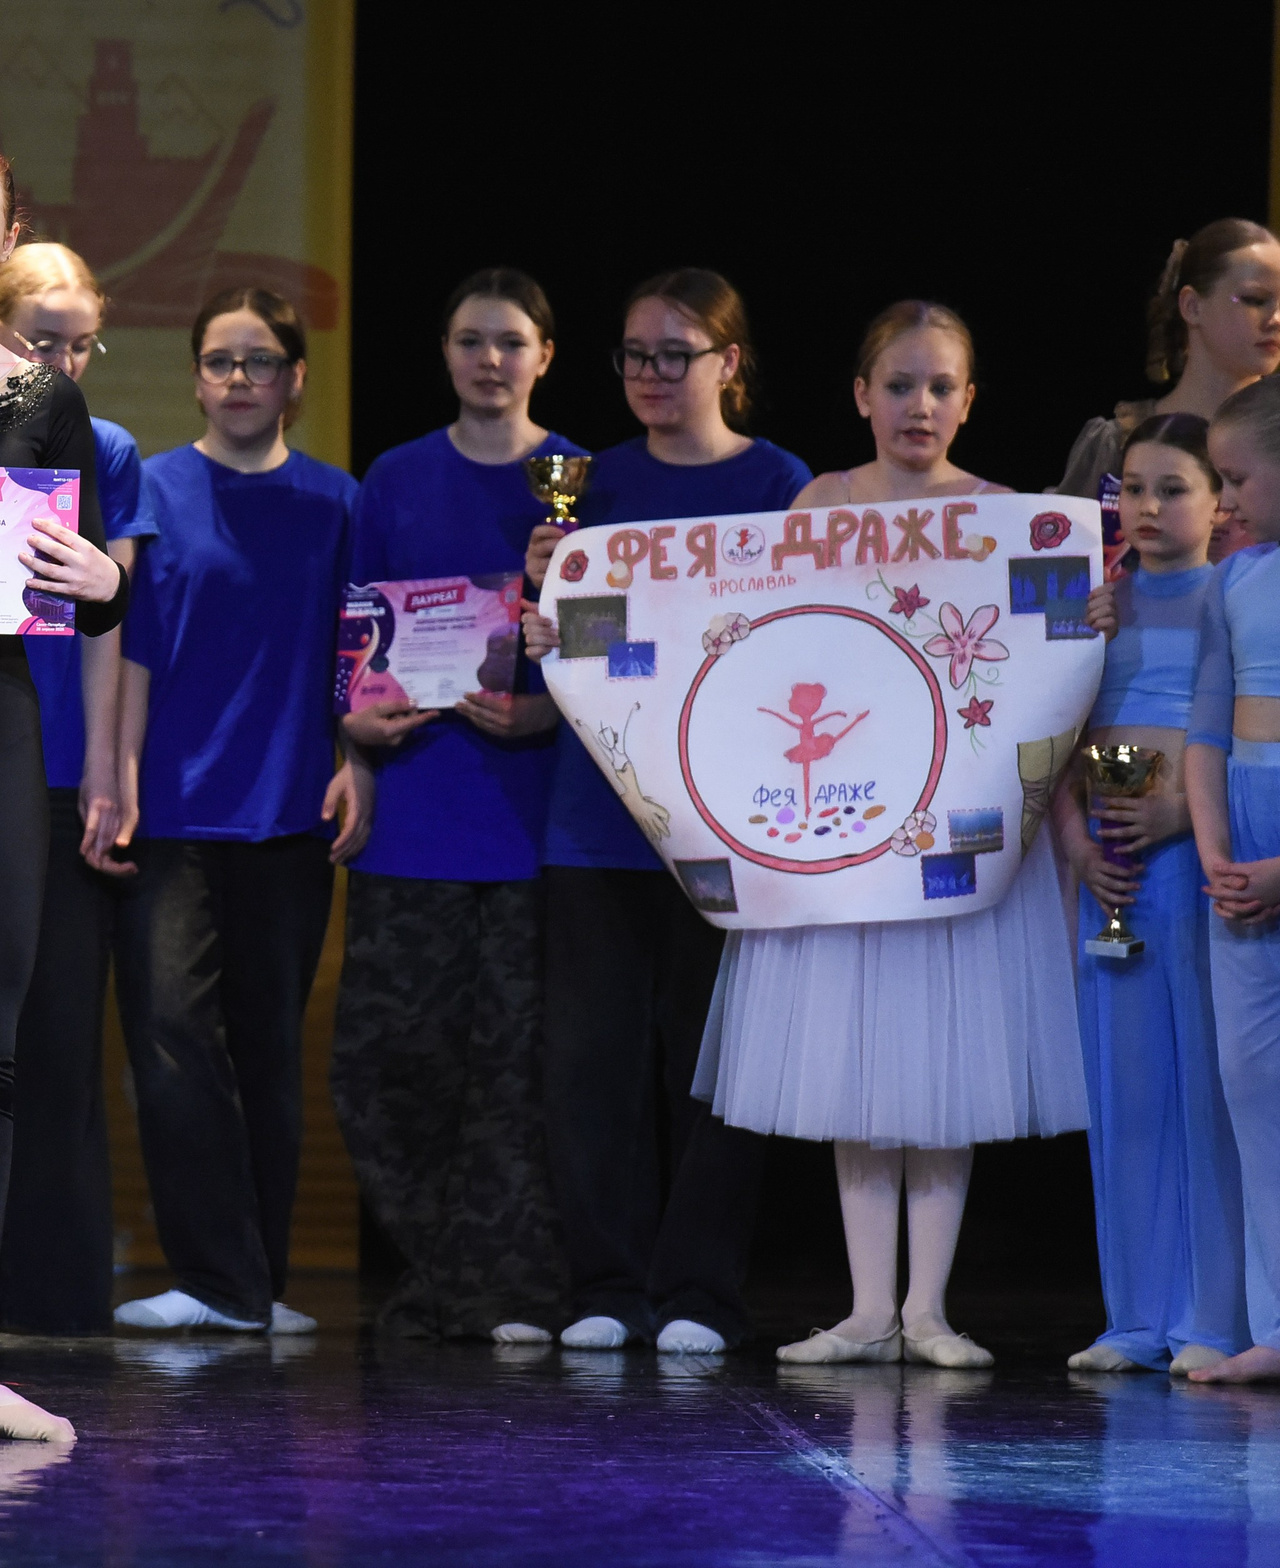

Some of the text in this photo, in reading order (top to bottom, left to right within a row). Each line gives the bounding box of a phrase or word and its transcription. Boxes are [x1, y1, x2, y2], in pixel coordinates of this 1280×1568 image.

[607, 502, 979, 581] ФЕЯ ДРАЖЕ
[708, 573, 797, 598] ЯРОСЛАВЛЬ
[752, 784, 797, 808] Фея
